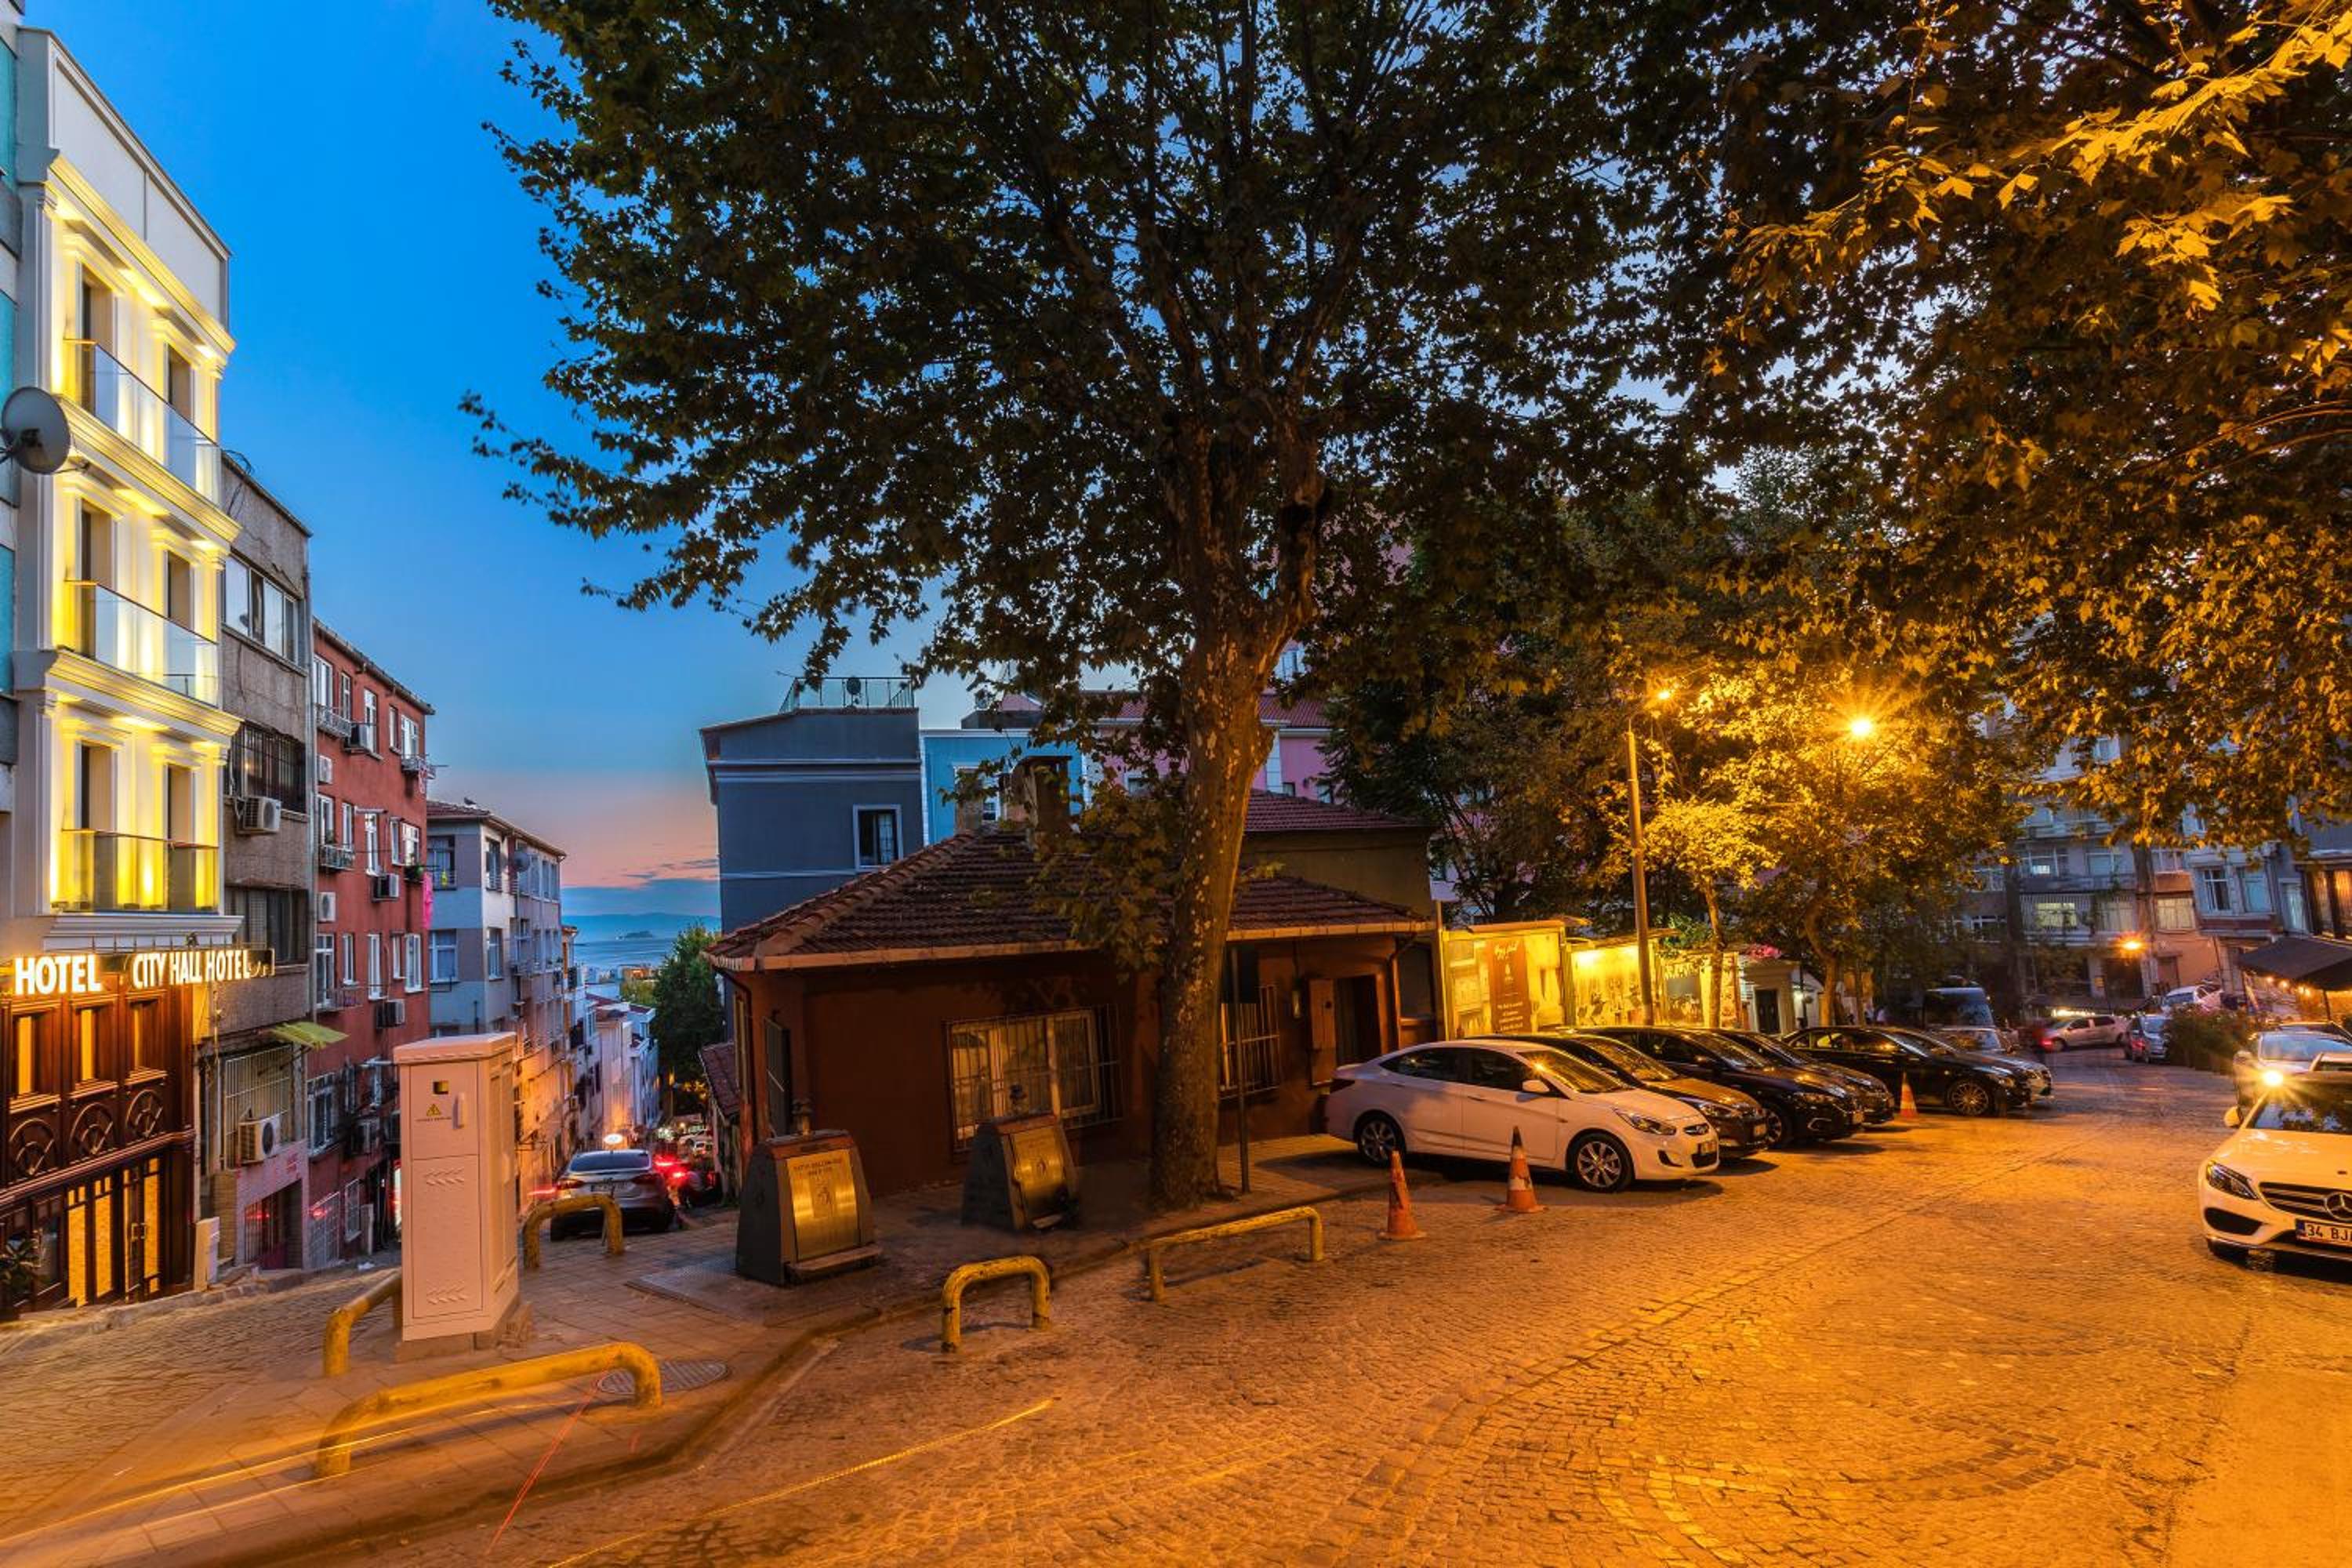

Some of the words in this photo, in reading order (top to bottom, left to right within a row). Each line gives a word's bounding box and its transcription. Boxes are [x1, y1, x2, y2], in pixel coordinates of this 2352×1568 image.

[15, 953, 101, 996] HOTEL
[132, 952, 167, 989] CITY
[169, 951, 203, 985] HALL
[205, 949, 250, 982] HOTEL
[2307, 1224, 2323, 1238] 34
[2331, 1227, 2352, 1242] BJ
